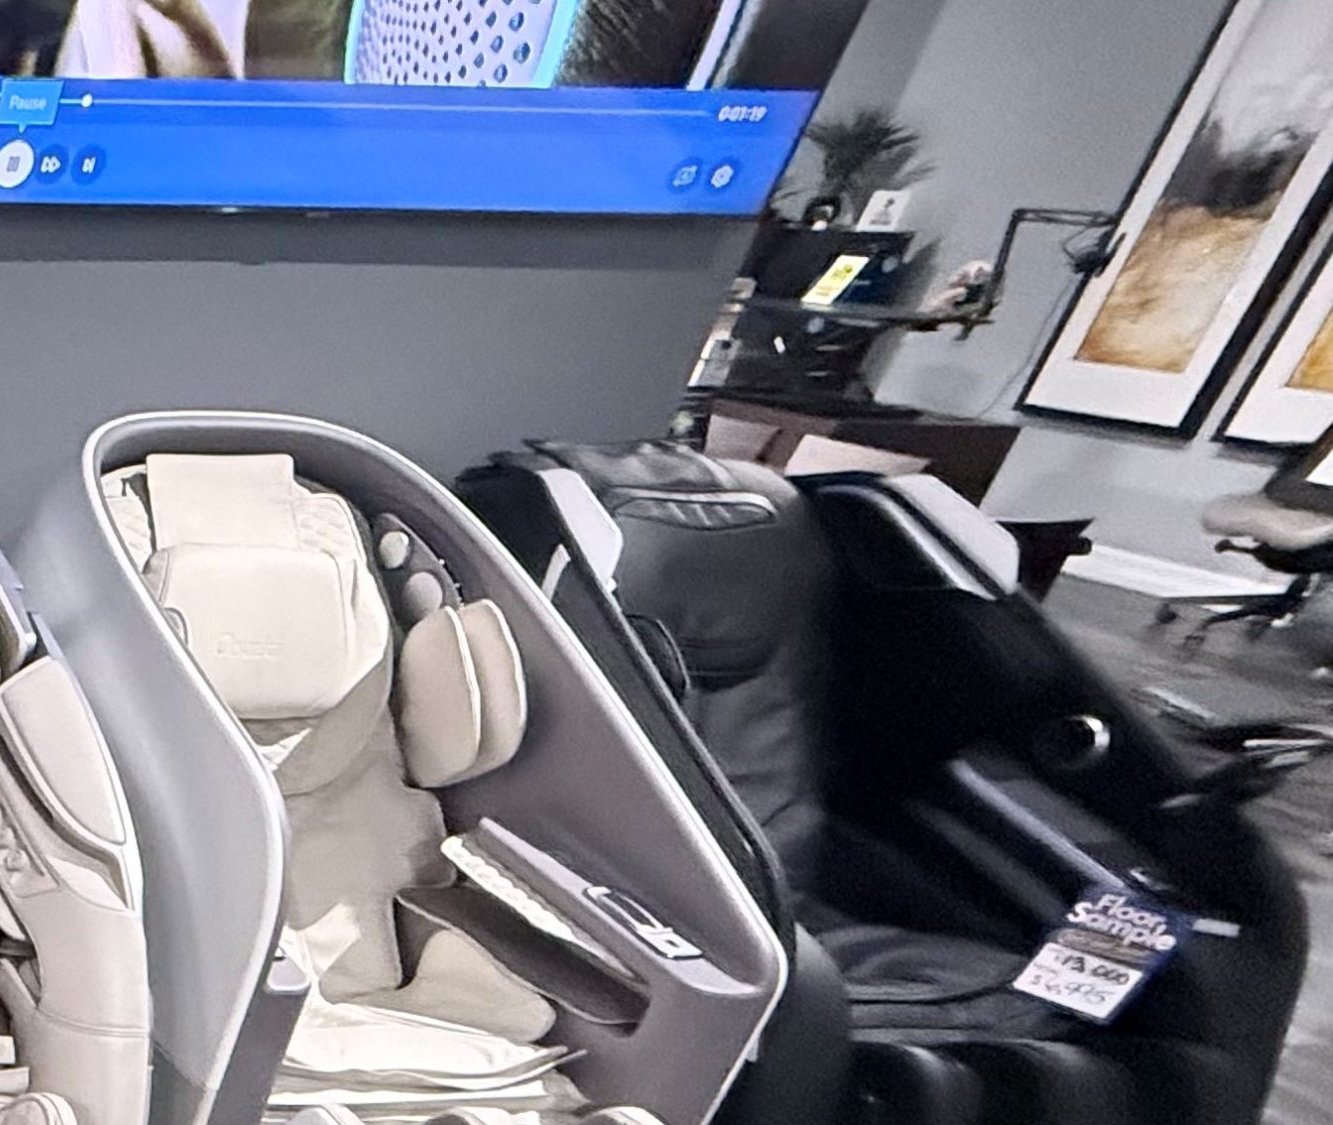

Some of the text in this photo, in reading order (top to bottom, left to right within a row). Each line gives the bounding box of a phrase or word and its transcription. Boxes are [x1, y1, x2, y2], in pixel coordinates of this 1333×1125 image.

[9, 94, 47, 110] Pause
[1066, 902, 1177, 950] Sample
[1096, 894, 1167, 927] Floor
